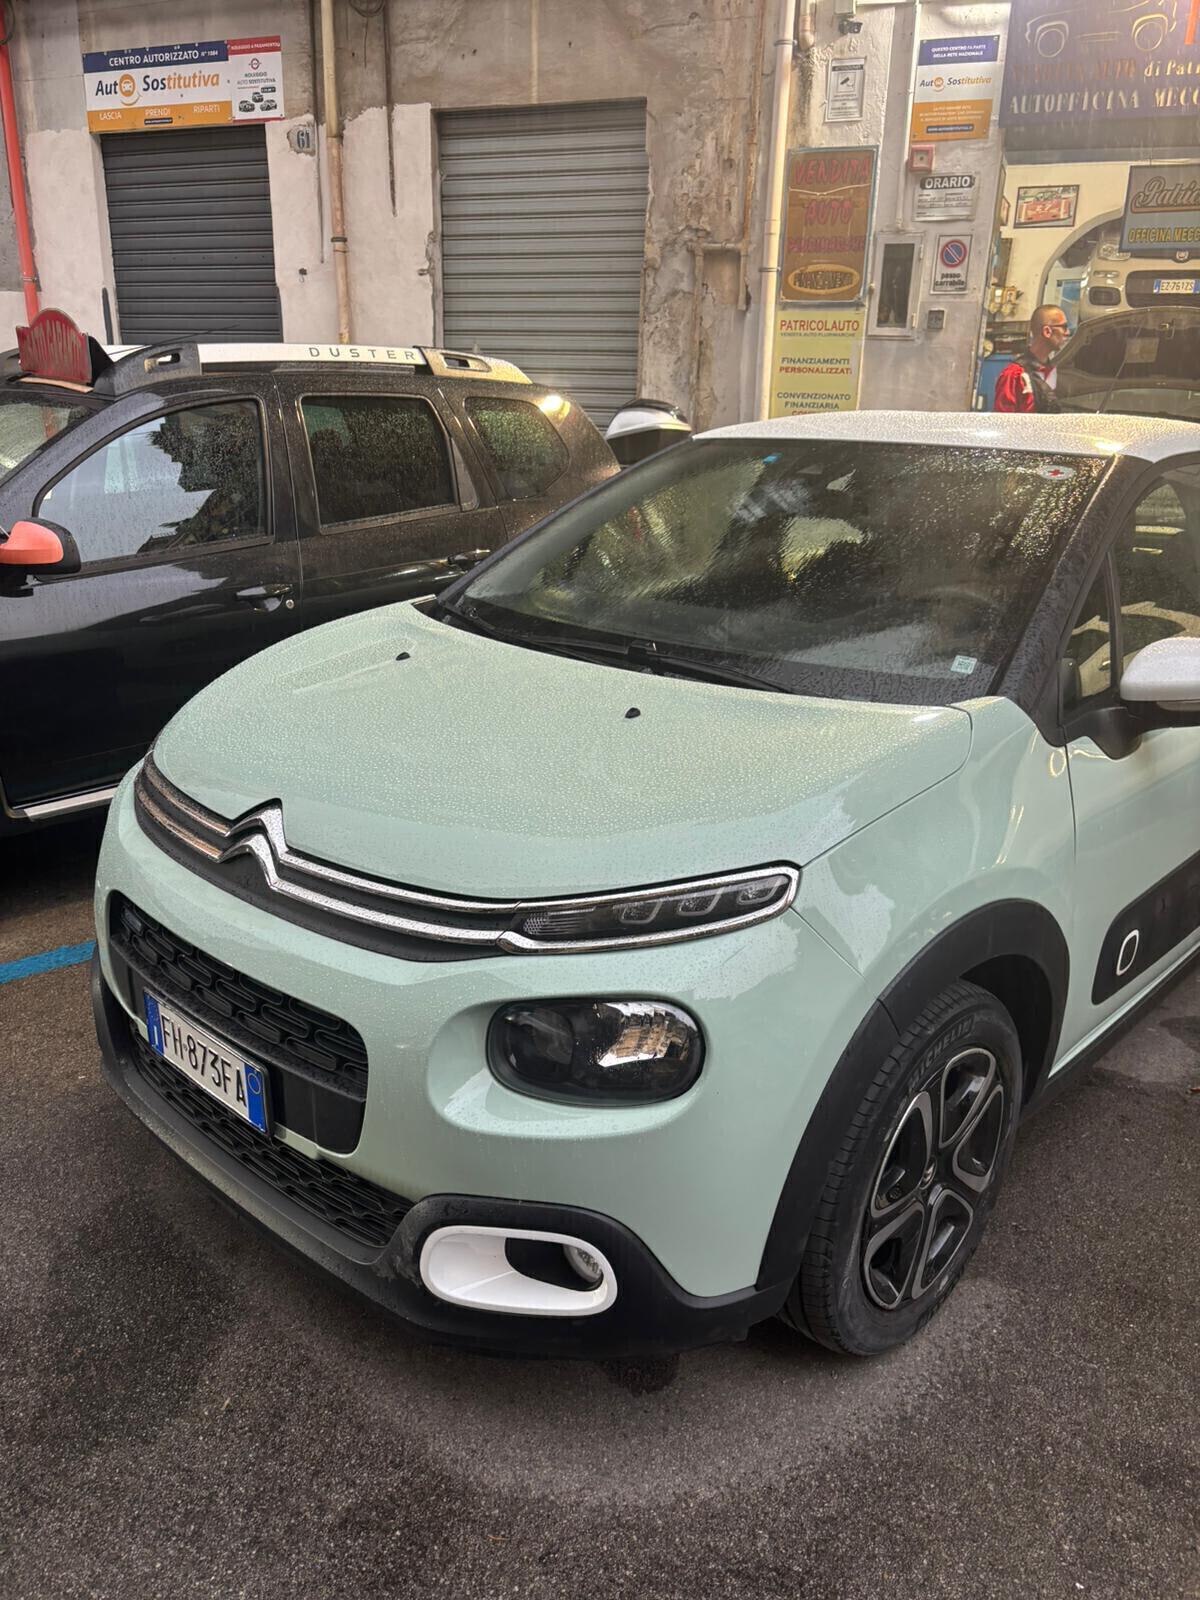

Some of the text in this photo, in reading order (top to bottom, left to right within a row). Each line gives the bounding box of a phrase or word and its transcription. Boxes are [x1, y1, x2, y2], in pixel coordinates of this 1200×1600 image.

[109, 55, 141, 67] CENTRO
[143, 50, 199, 63] AUTORIZZATO
[1144, 60, 1160, 77] di
[142, 70, 220, 92] Sostitutiva
[947, 75, 992, 86] Sostitutiva
[1010, 88, 1139, 114] AUTOFFICINA
[99, 104, 220, 121] LASCIA PRENDI RIPARTI
[296, 130, 310, 149] 61
[793, 157, 871, 185] VENDITA
[925, 176, 971, 189] ORARIO
[805, 197, 854, 226] AUTO
[1128, 226, 1171, 243] OFFICINA
[935, 279, 965, 287] carrabile
[780, 319, 860, 331] PATRICOLAUTO
[309, 347, 416, 361] DUSTER
[781, 357, 850, 365] FINANZIAMENTI
[779, 366, 852, 375] PERSONALIZZATI
[777, 391, 851, 401] CONVENZIONATO
[784, 401, 840, 410] FINANZIARIA
